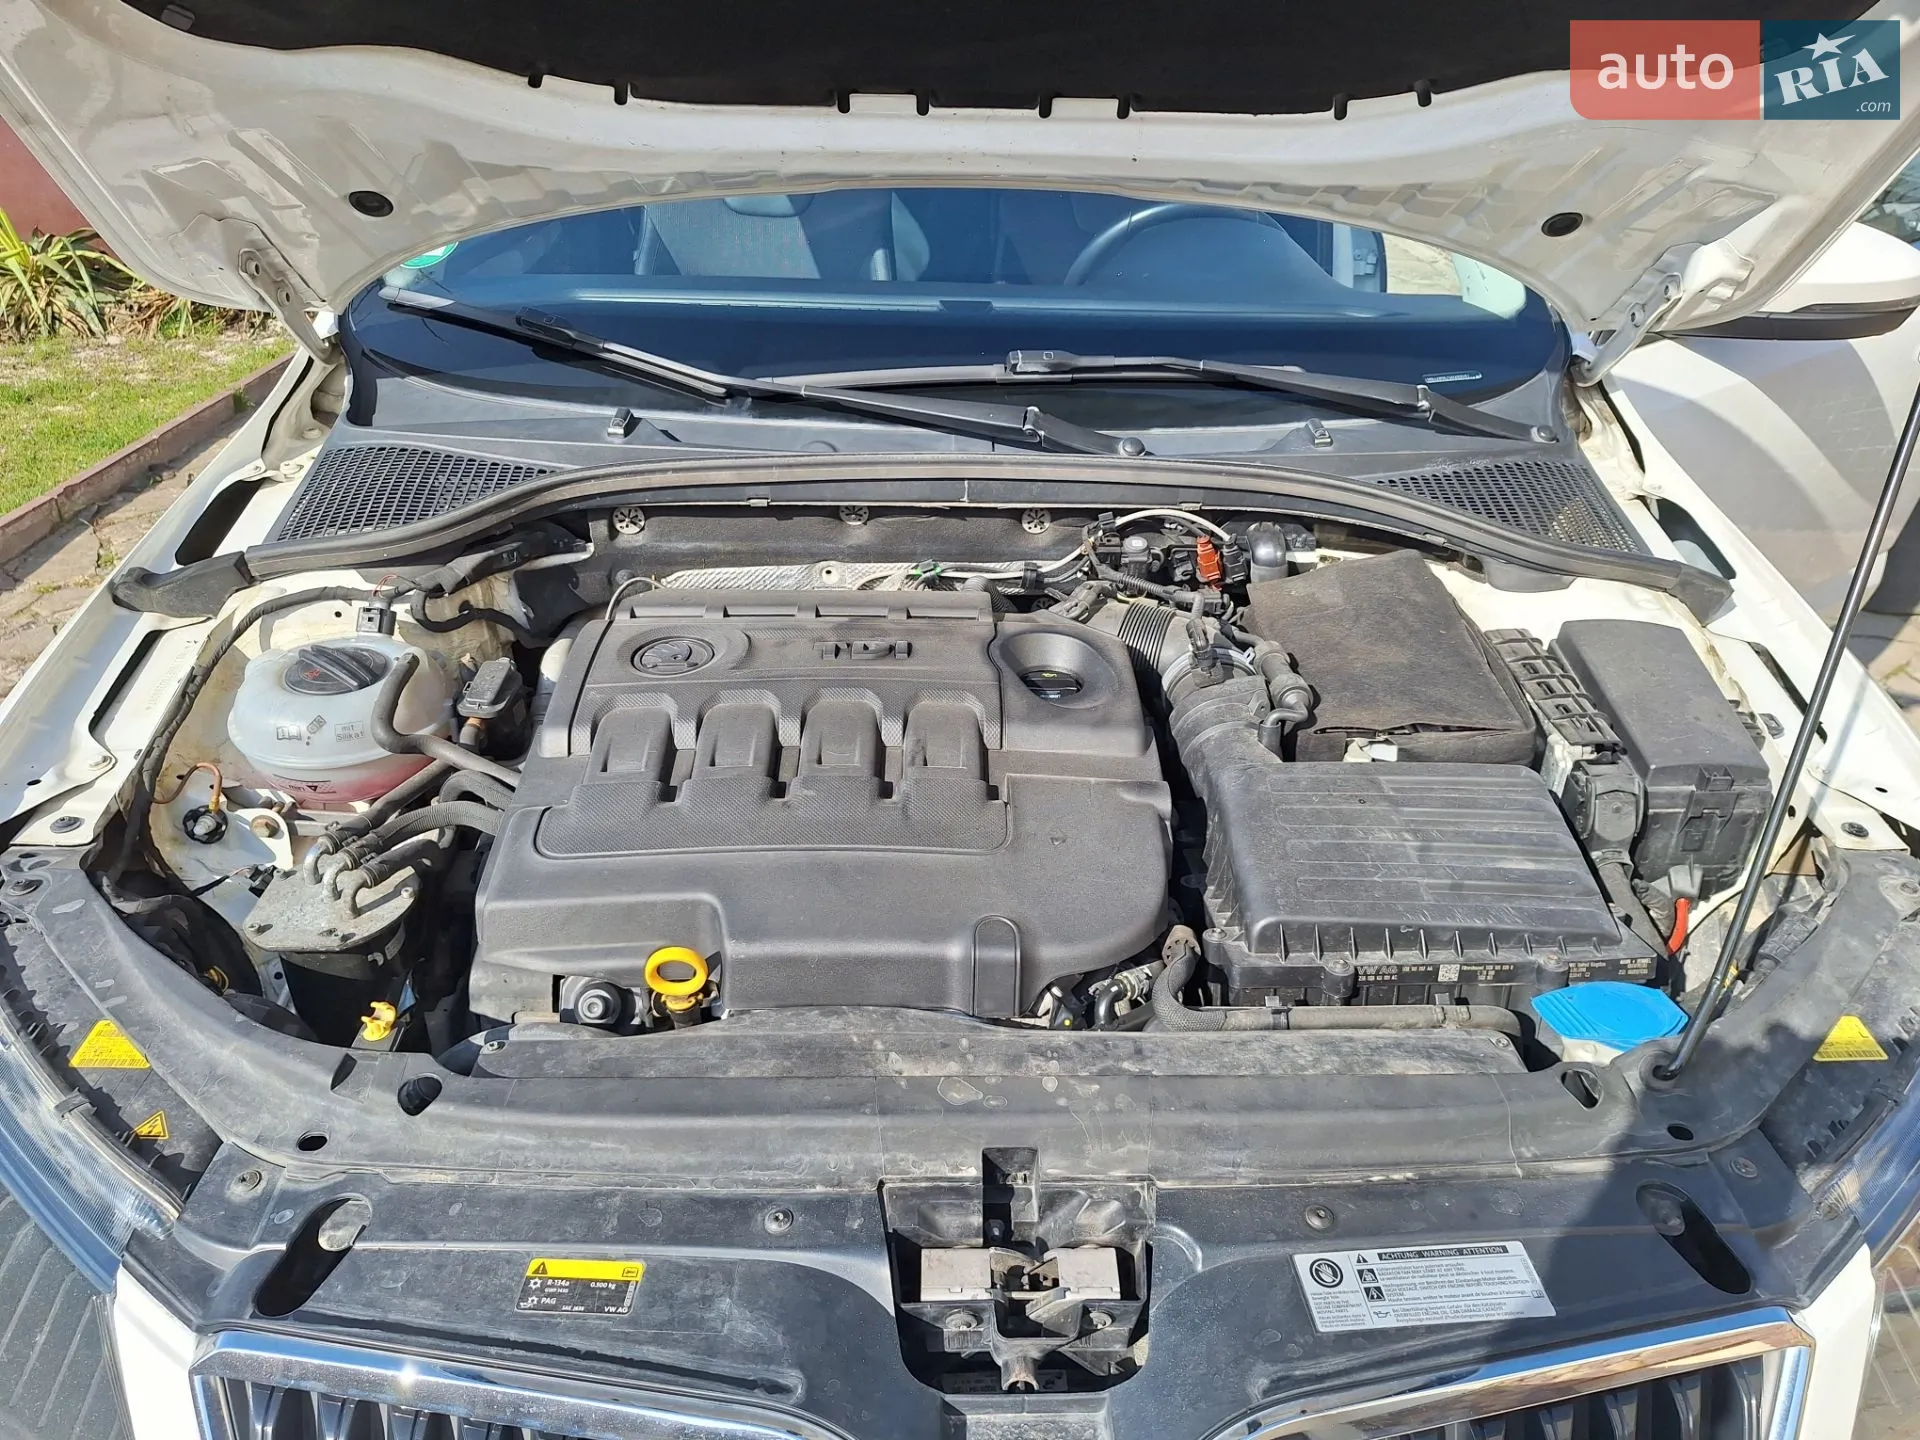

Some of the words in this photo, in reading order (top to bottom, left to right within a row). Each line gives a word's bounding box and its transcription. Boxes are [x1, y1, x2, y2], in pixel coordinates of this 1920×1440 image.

[1357, 965, 1378, 975] VW
[1380, 965, 1398, 974] AG
[1382, 1252, 1420, 1260] ACHTUNG
[1421, 1249, 1460, 1258] WARNING
[1462, 1246, 1502, 1255] ATTENTION
